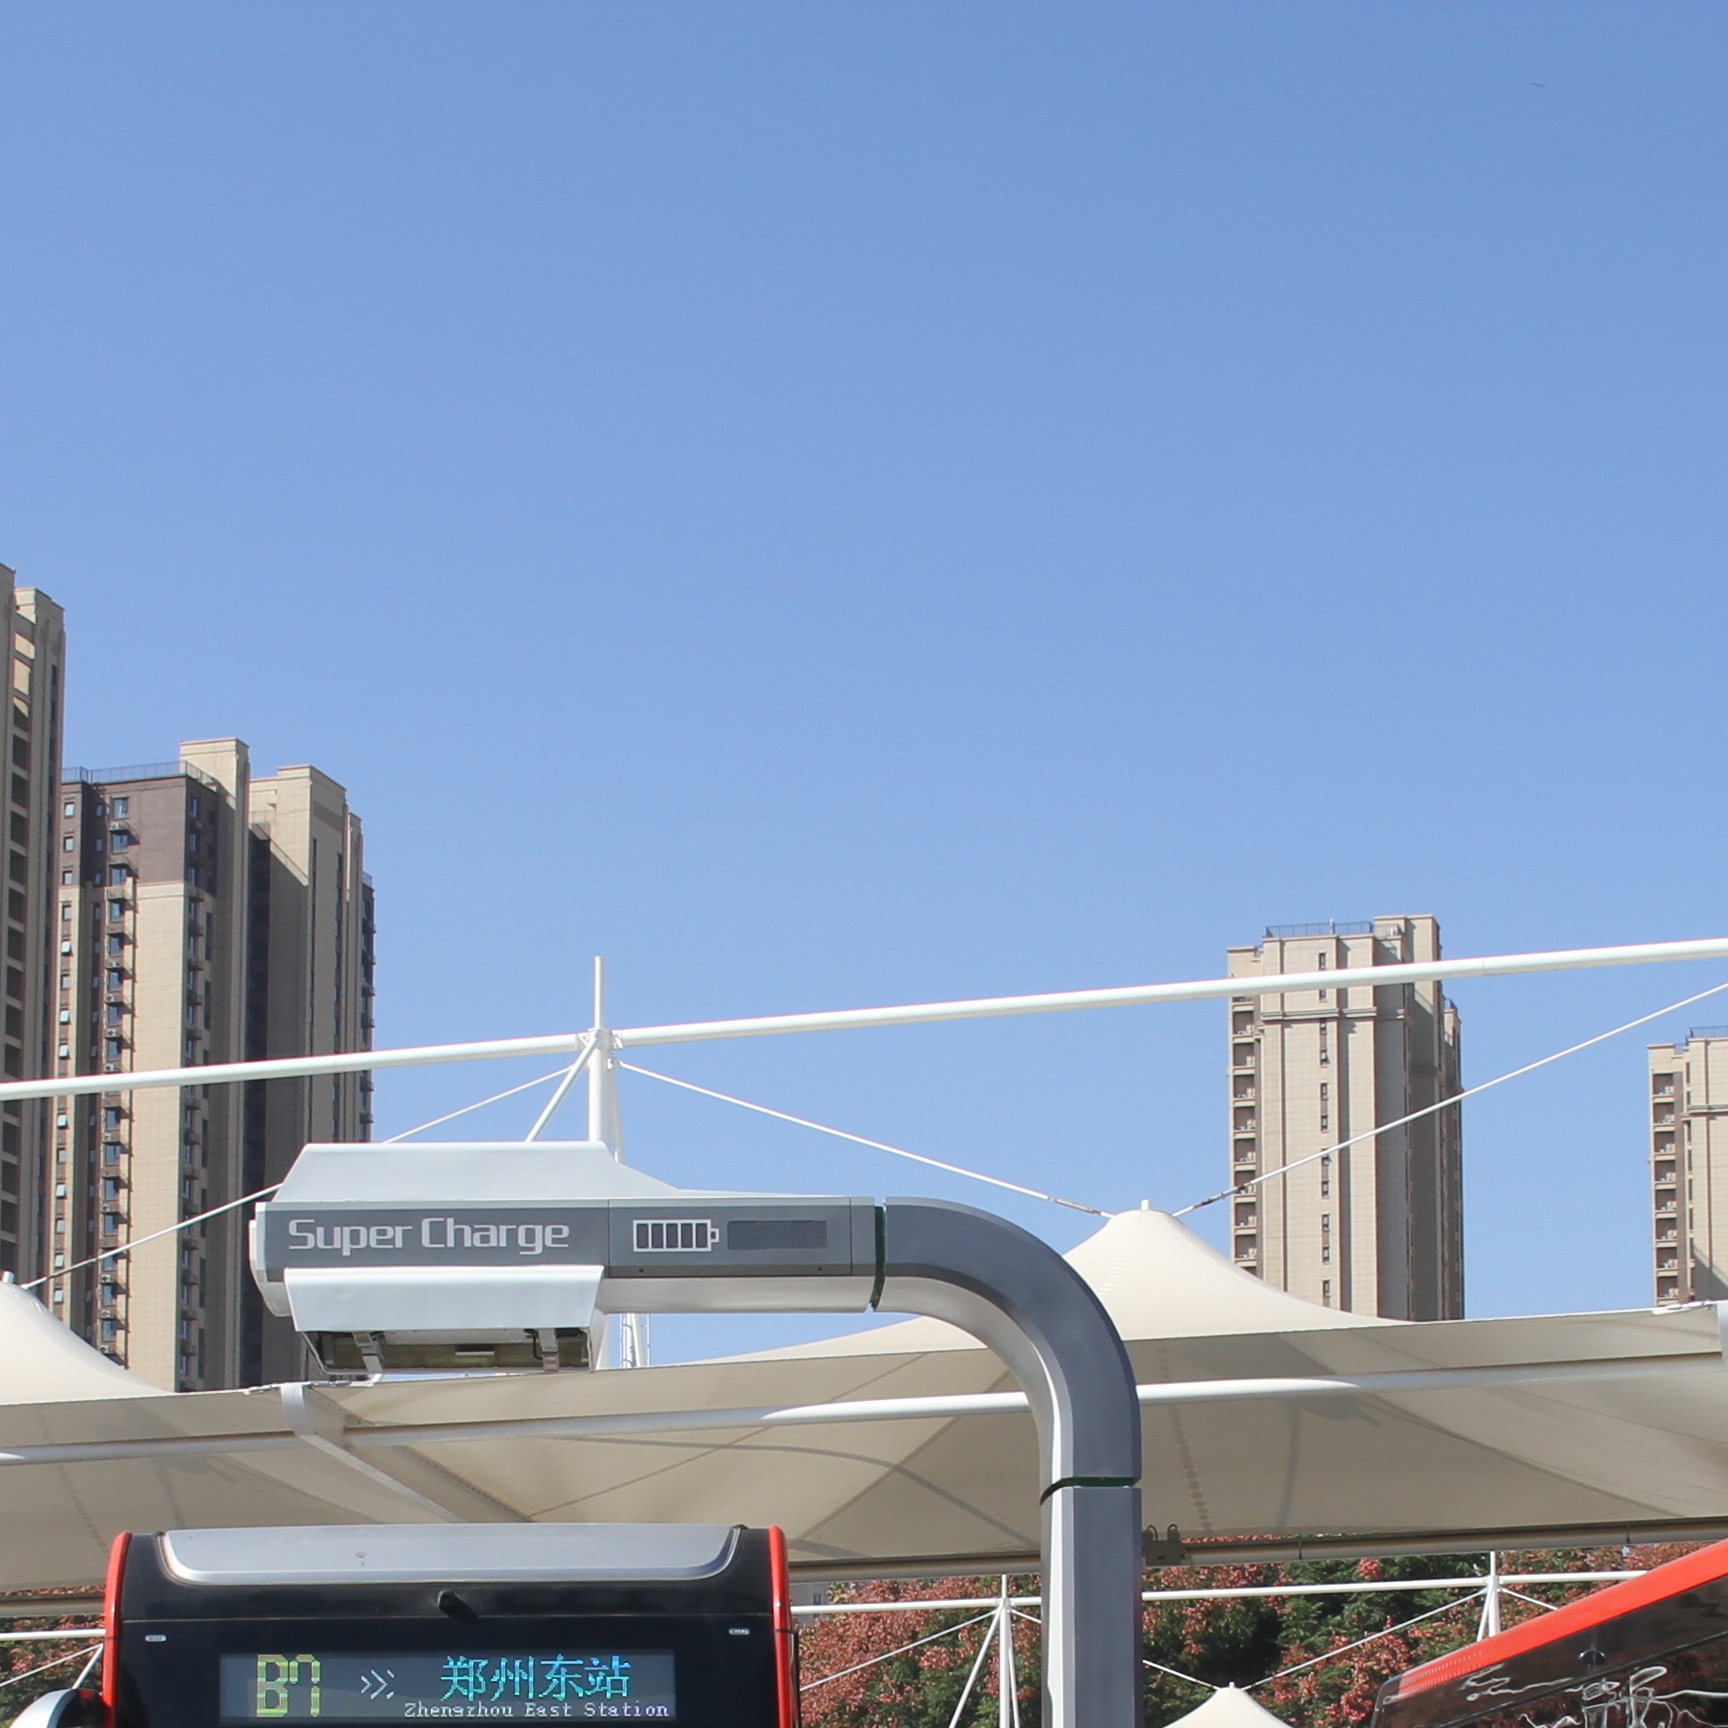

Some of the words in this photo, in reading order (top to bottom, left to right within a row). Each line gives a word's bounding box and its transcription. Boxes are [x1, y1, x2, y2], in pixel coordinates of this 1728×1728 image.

[288, 1218, 412, 1256] Super
[420, 1217, 569, 1255] Charge
[256, 1653, 321, 1718] B7
[440, 1654, 632, 1701] 郑州东站
[524, 1702, 572, 1718] East
[584, 1700, 669, 1718] Station
